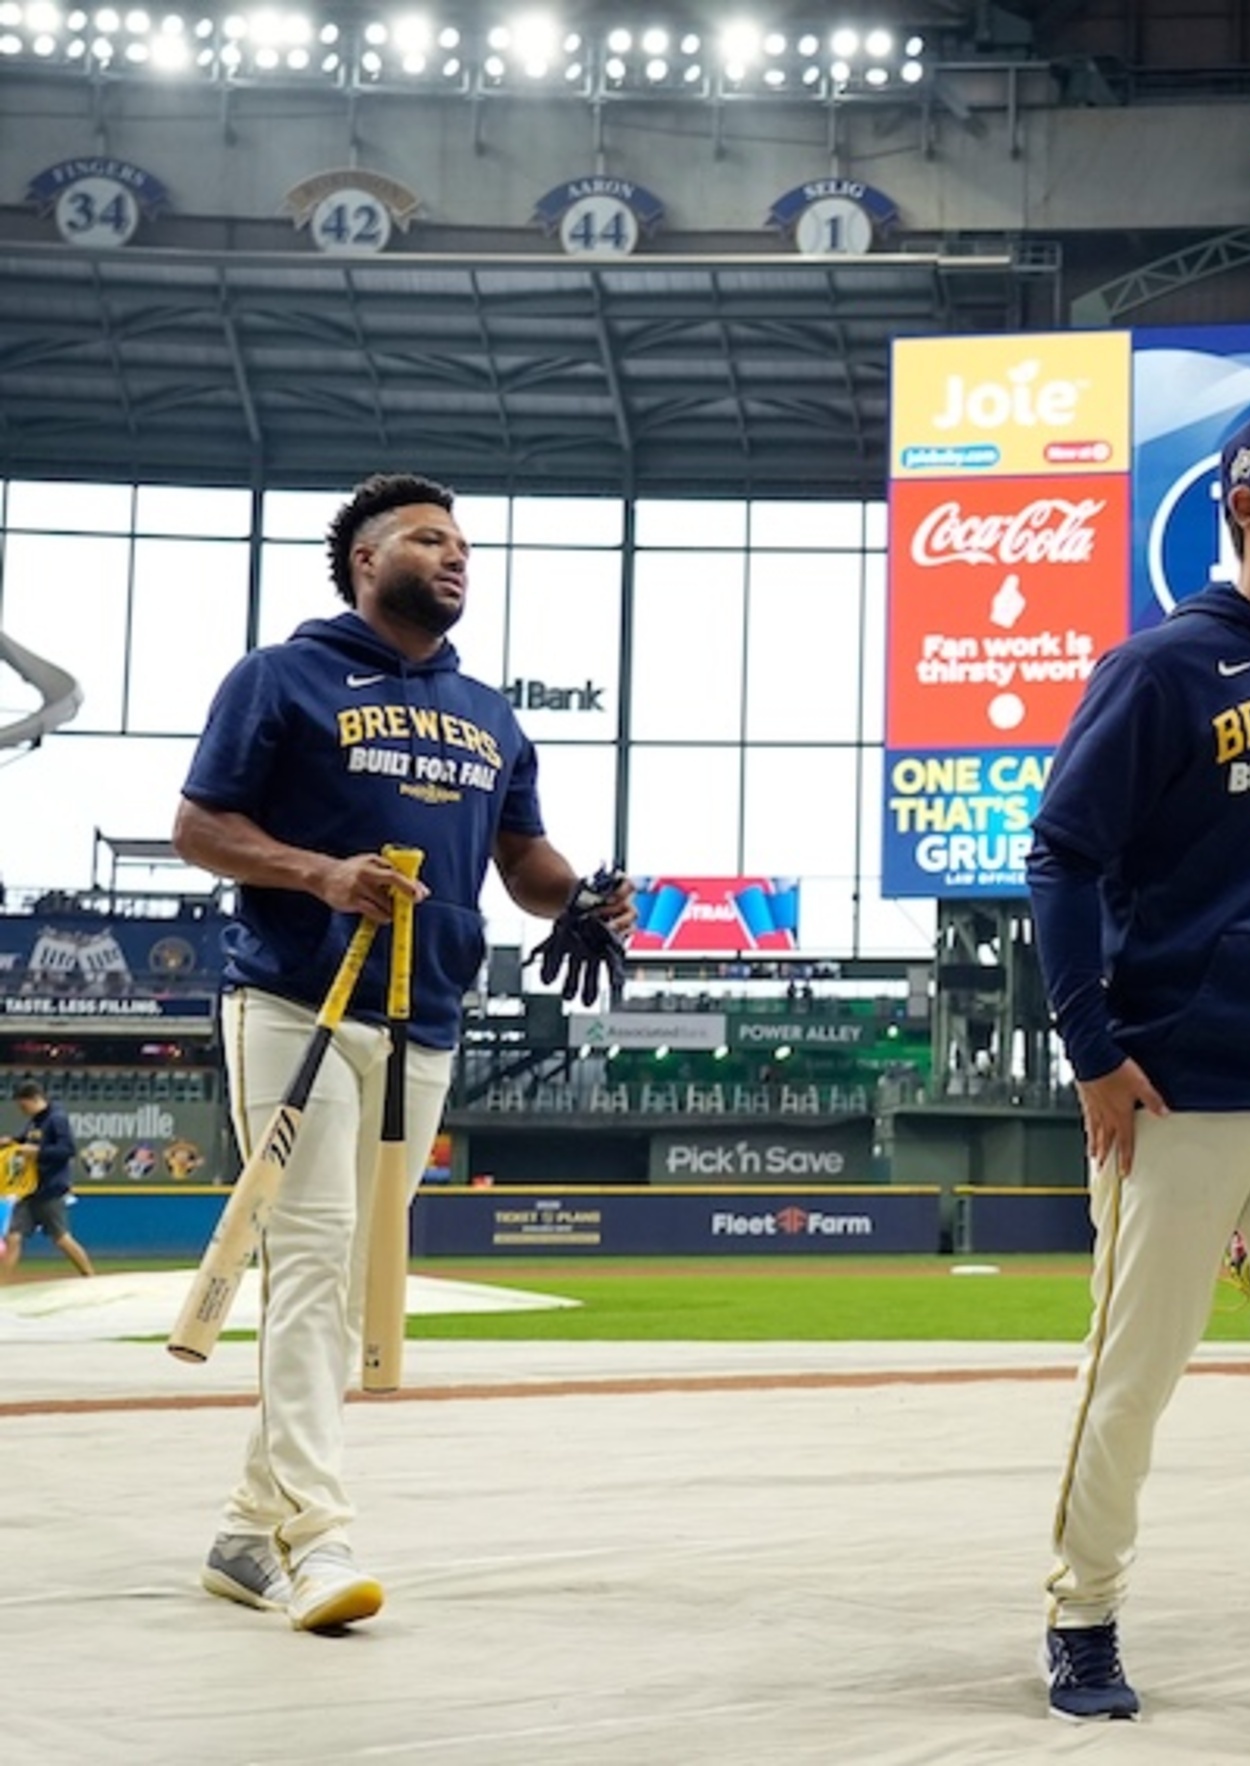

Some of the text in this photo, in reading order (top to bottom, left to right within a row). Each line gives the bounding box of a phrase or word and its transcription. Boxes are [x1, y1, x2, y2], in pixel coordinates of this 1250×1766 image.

[52, 161, 144, 187] FINGERS
[567, 179, 637, 199] AARON
[803, 180, 867, 199] SELIG
[66, 192, 127, 235] 34
[321, 203, 382, 245] 42
[568, 212, 630, 251] 44
[824, 215, 848, 251] 1
[931, 358, 1080, 430] Joie
[910, 498, 1108, 568] Coca-Cola
[922, 630, 1093, 658] Fan work is
[916, 659, 1016, 688] thirsty
[527, 679, 606, 711] Bank
[337, 705, 503, 770] BREWERS
[348, 747, 411, 776] BUILT
[415, 756, 457, 783] FOR
[892, 757, 982, 796] ONE
[889, 794, 1031, 833] THAT'S
[739, 1024, 863, 1042] POWER ALLEY
[765, 1146, 845, 1175] Save
[711, 1212, 872, 1235] Fleet Farm
